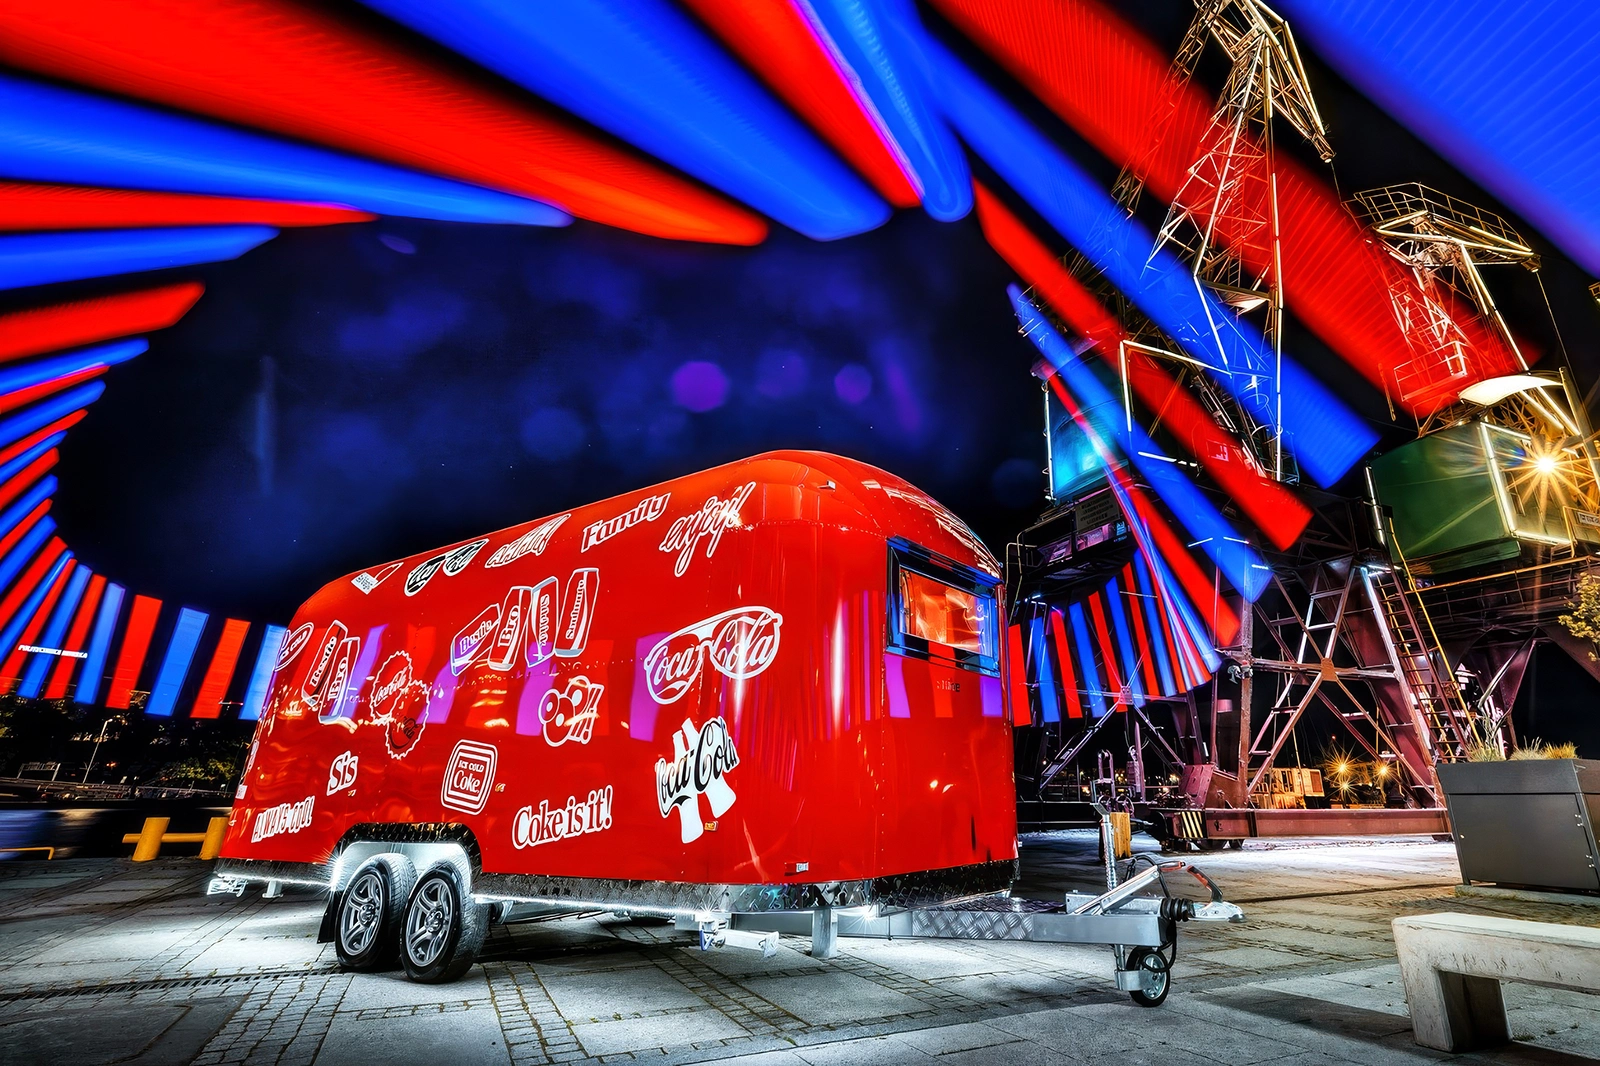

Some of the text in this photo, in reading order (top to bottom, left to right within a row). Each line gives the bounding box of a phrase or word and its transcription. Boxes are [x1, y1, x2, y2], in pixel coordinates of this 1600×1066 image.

[582, 493, 670, 552] Family
[460, 620, 491, 654] Bestie
[498, 606, 519, 647] Bro
[328, 752, 358, 794] Sis
[454, 770, 480, 793] Coke
[469, 763, 484, 773] COLD
[512, 786, 613, 848] Coke is it!
